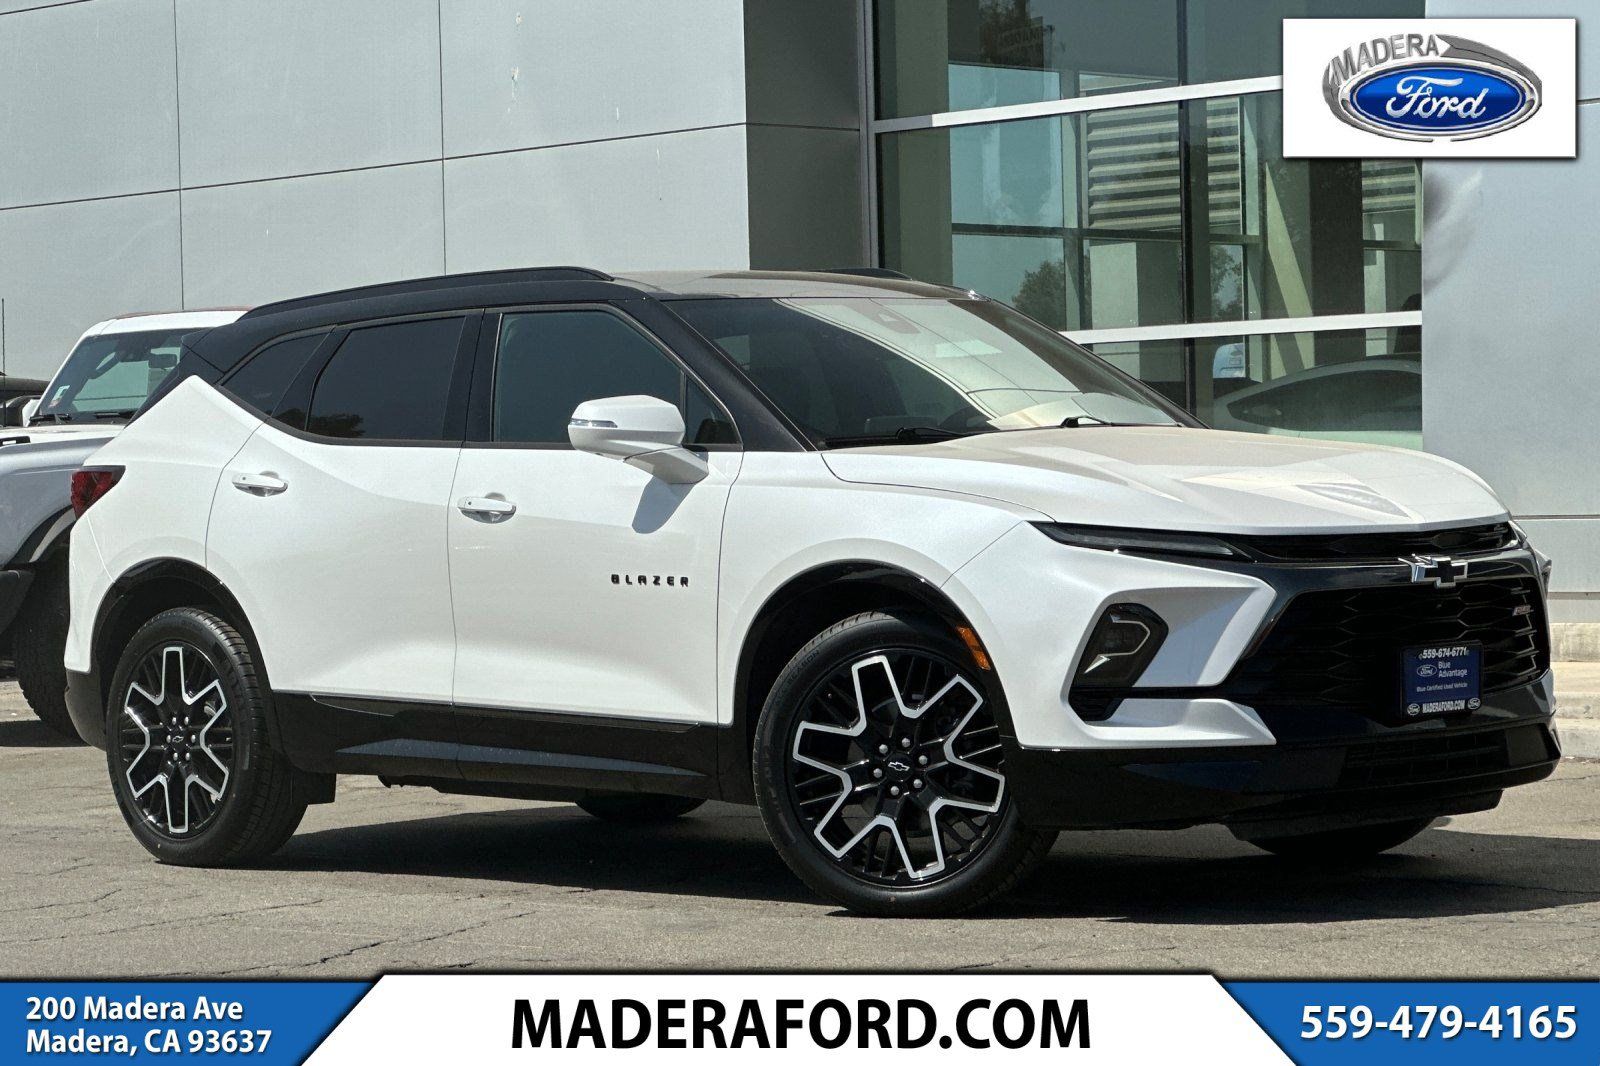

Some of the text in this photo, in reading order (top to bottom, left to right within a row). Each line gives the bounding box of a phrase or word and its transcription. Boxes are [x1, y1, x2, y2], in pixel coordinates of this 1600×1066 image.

[610, 573, 689, 588] BLAZER
[1422, 646, 1467, 659] 559-674-6771
[1438, 661, 1451, 669] Blue
[1438, 668, 1468, 678] Advantage
[1422, 700, 1466, 714] MADERAFORD.COM
